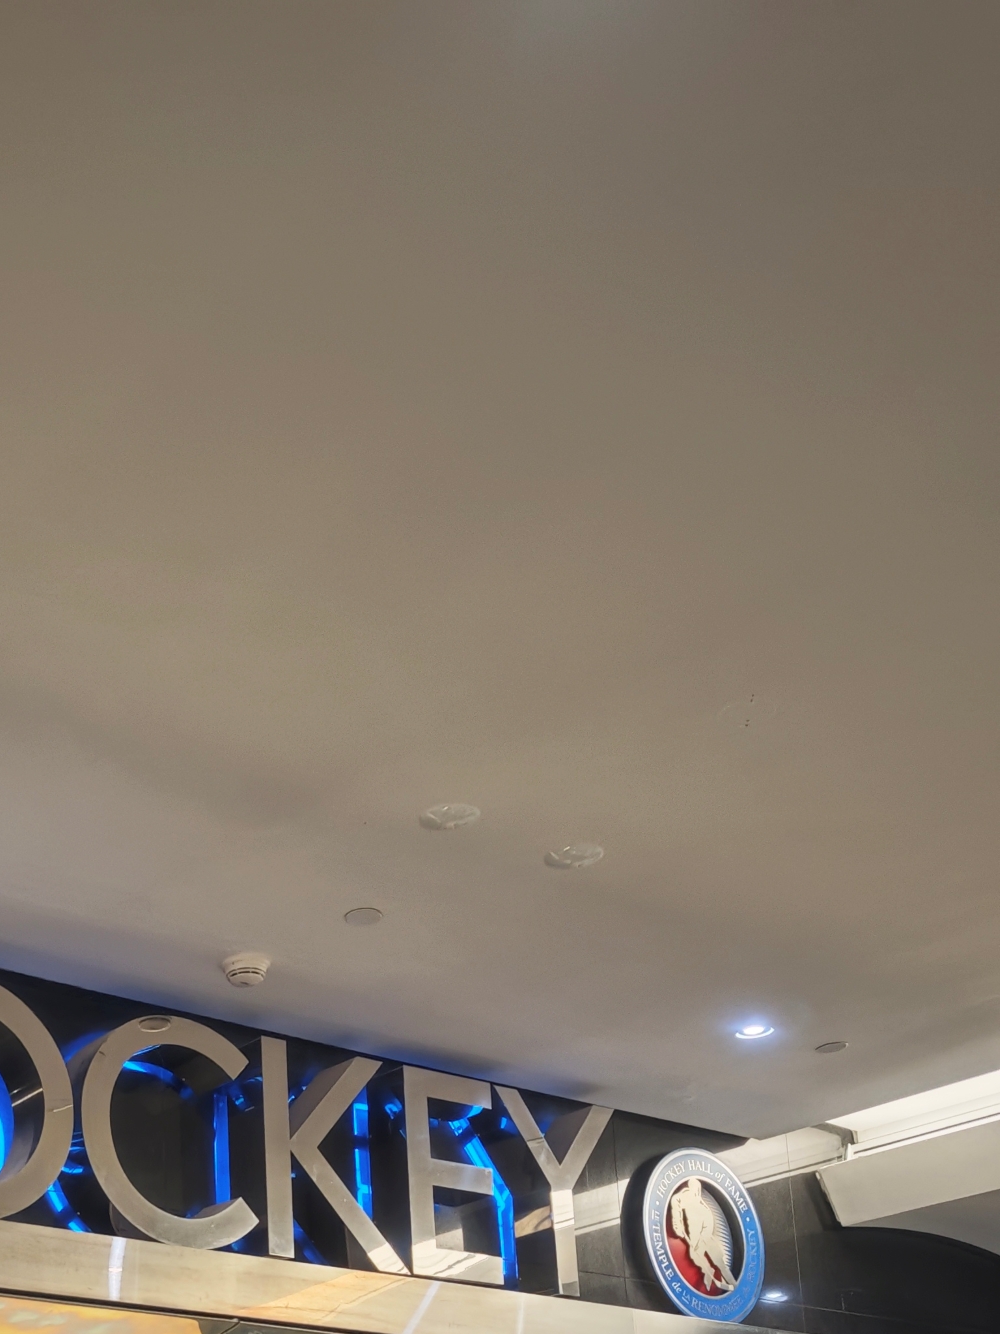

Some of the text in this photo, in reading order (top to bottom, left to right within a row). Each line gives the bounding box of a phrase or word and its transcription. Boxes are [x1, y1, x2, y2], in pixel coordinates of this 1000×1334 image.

[656, 1159, 749, 1214] HOCKEY HALL of FAME
[652, 1221, 676, 1281] TEMPLE
[671, 1281, 683, 1294] de
